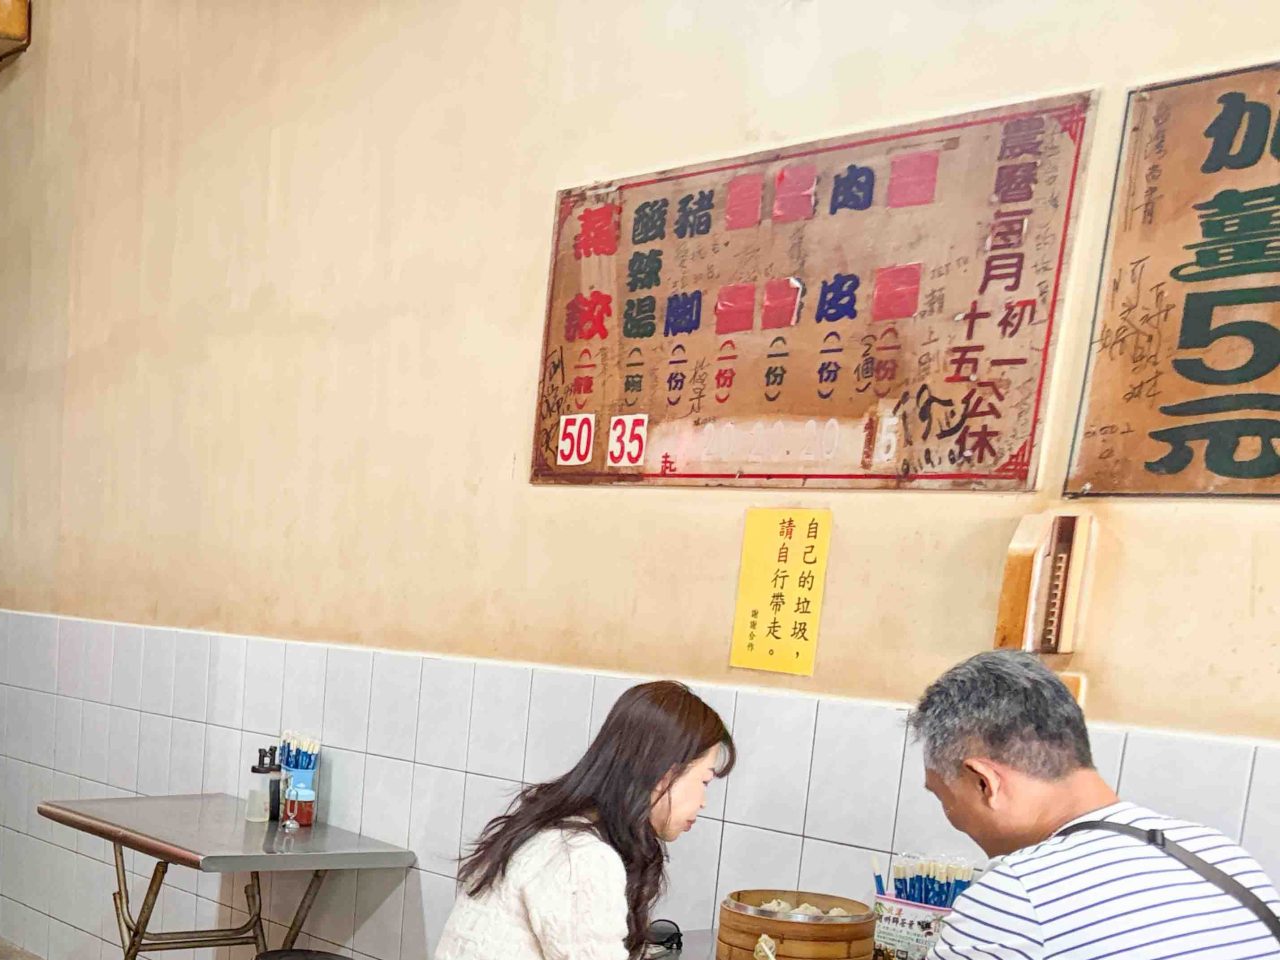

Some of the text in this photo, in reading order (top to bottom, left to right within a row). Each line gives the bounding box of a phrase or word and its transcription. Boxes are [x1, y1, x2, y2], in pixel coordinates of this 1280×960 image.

[622, 198, 669, 339] 酸辣湯
[943, 300, 992, 383] 十五
[559, 417, 593, 463] 50
[609, 418, 645, 465] 35
[954, 380, 1005, 464] 公休
